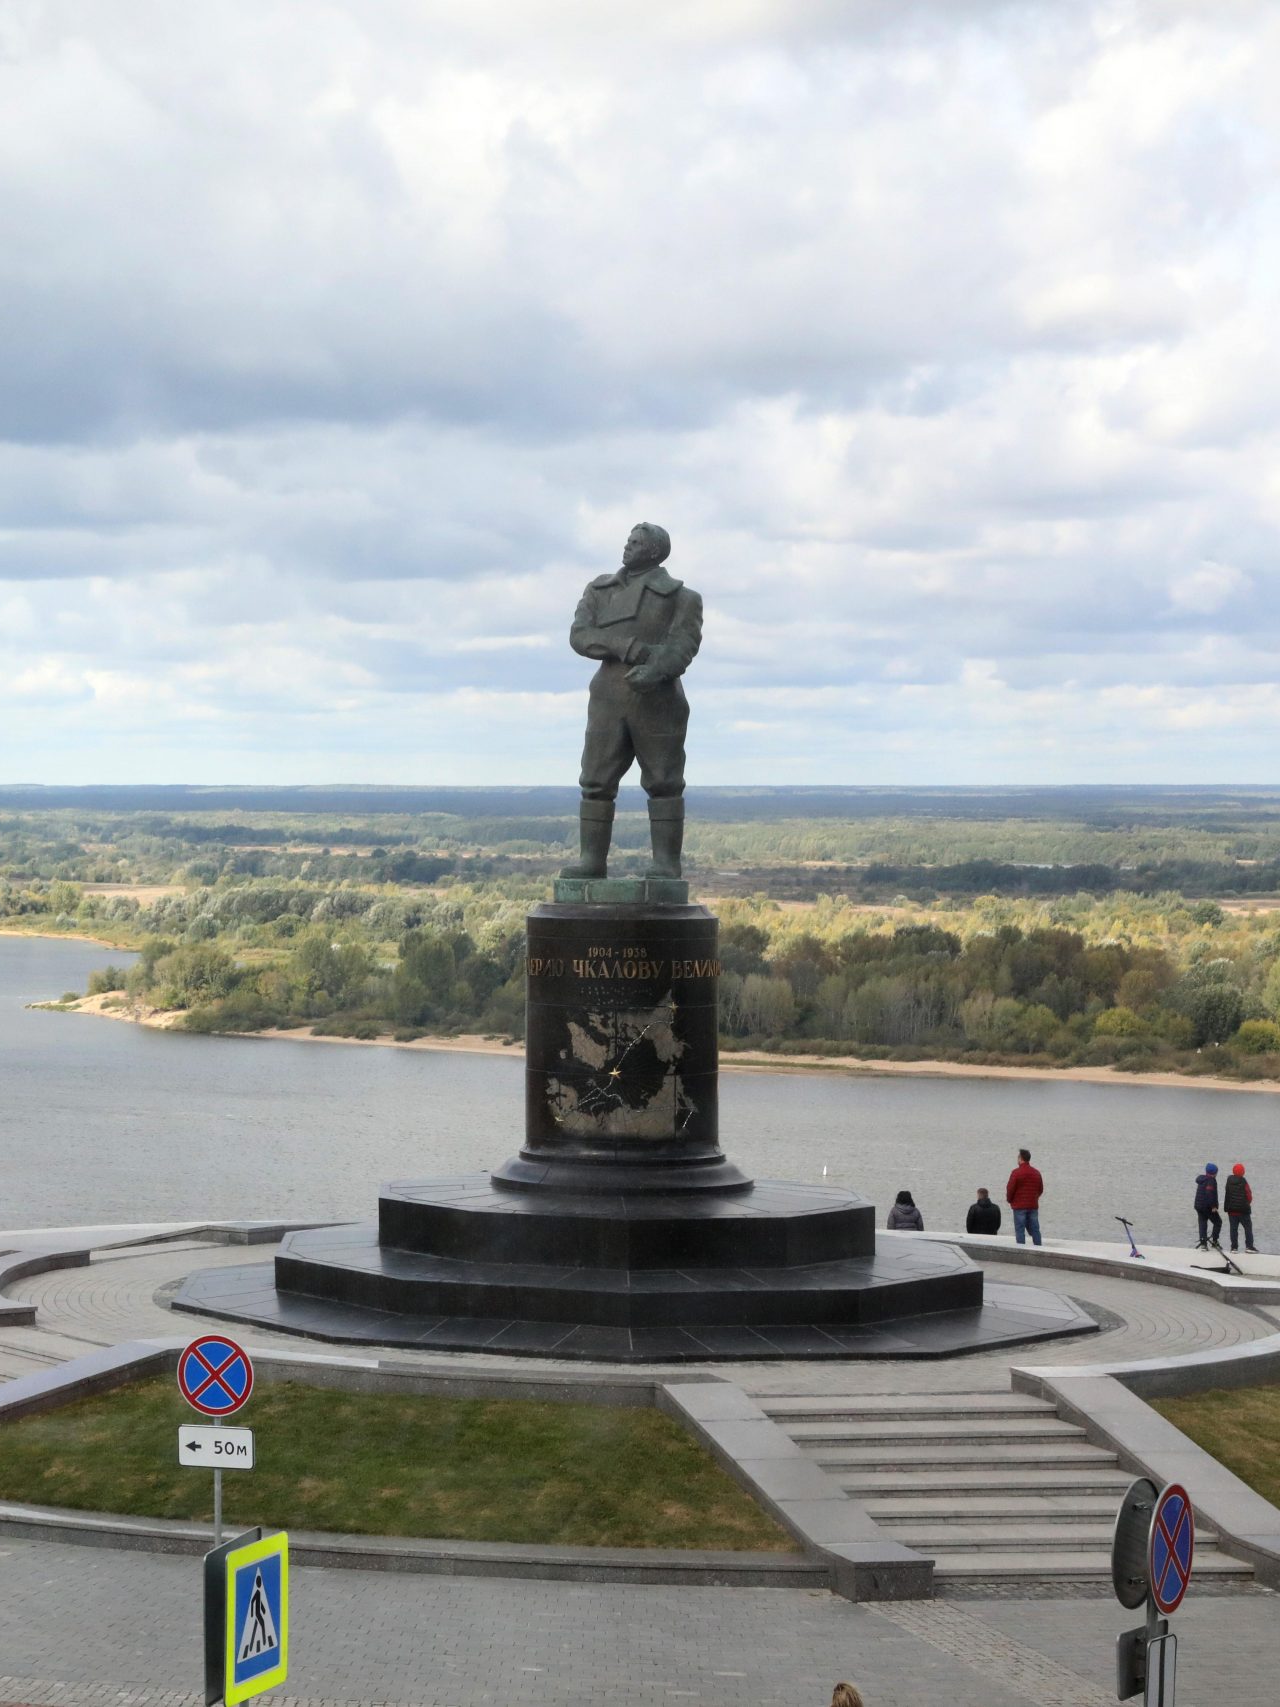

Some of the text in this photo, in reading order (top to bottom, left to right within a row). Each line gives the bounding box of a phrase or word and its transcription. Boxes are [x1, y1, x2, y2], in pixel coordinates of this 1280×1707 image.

[588, 947, 612, 958] 1904
[623, 947, 648, 958] 1938
[572, 959, 665, 979] ЧКАЛОВУ
